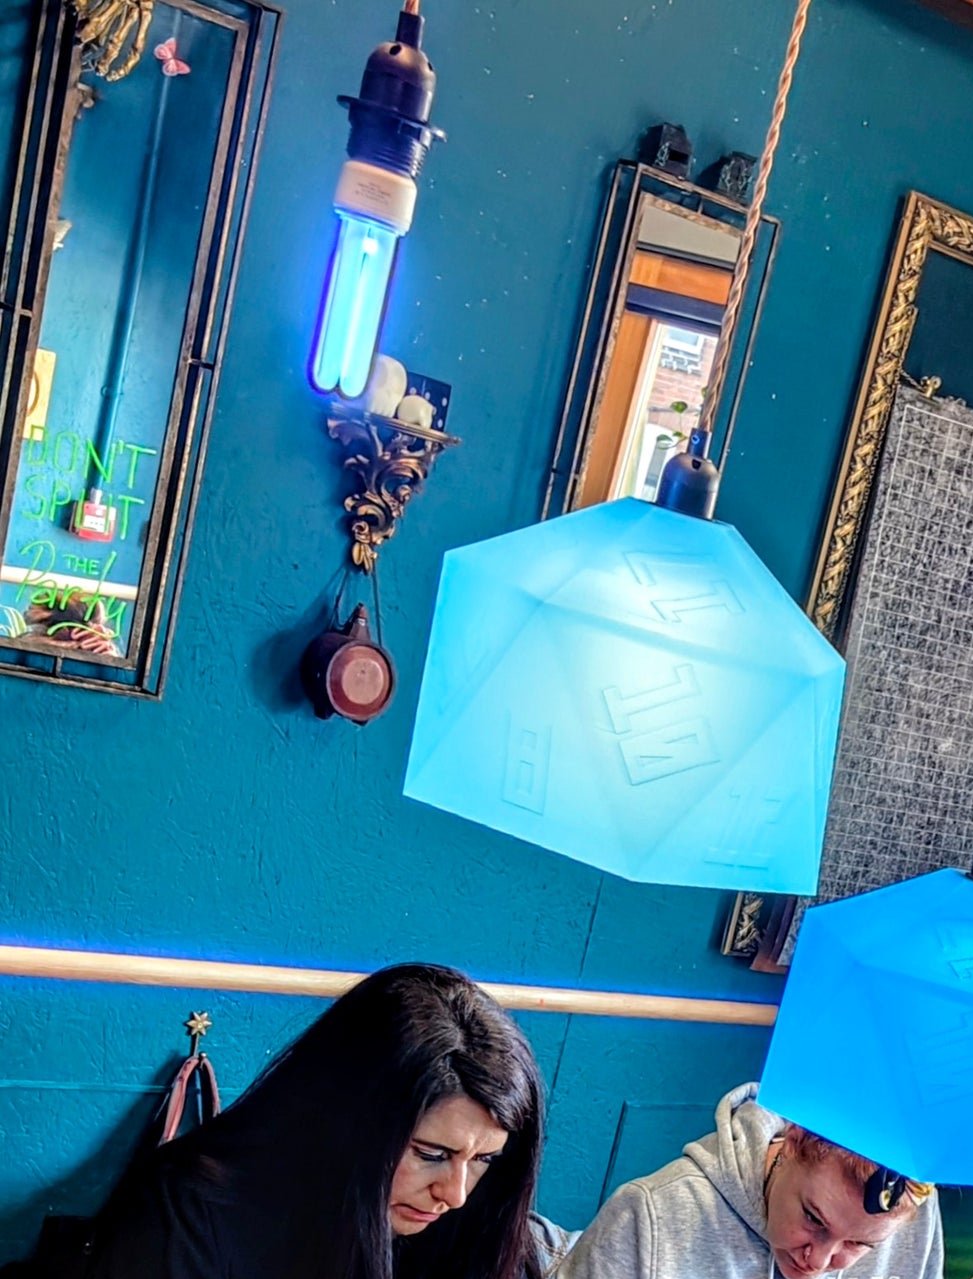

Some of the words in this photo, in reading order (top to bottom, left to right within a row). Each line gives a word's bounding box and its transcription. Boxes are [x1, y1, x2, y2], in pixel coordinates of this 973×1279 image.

[26, 424, 157, 490] DON'T
[22, 474, 146, 541] SPLIT
[15, 540, 127, 639] Party
[62, 554, 101, 577] THE
